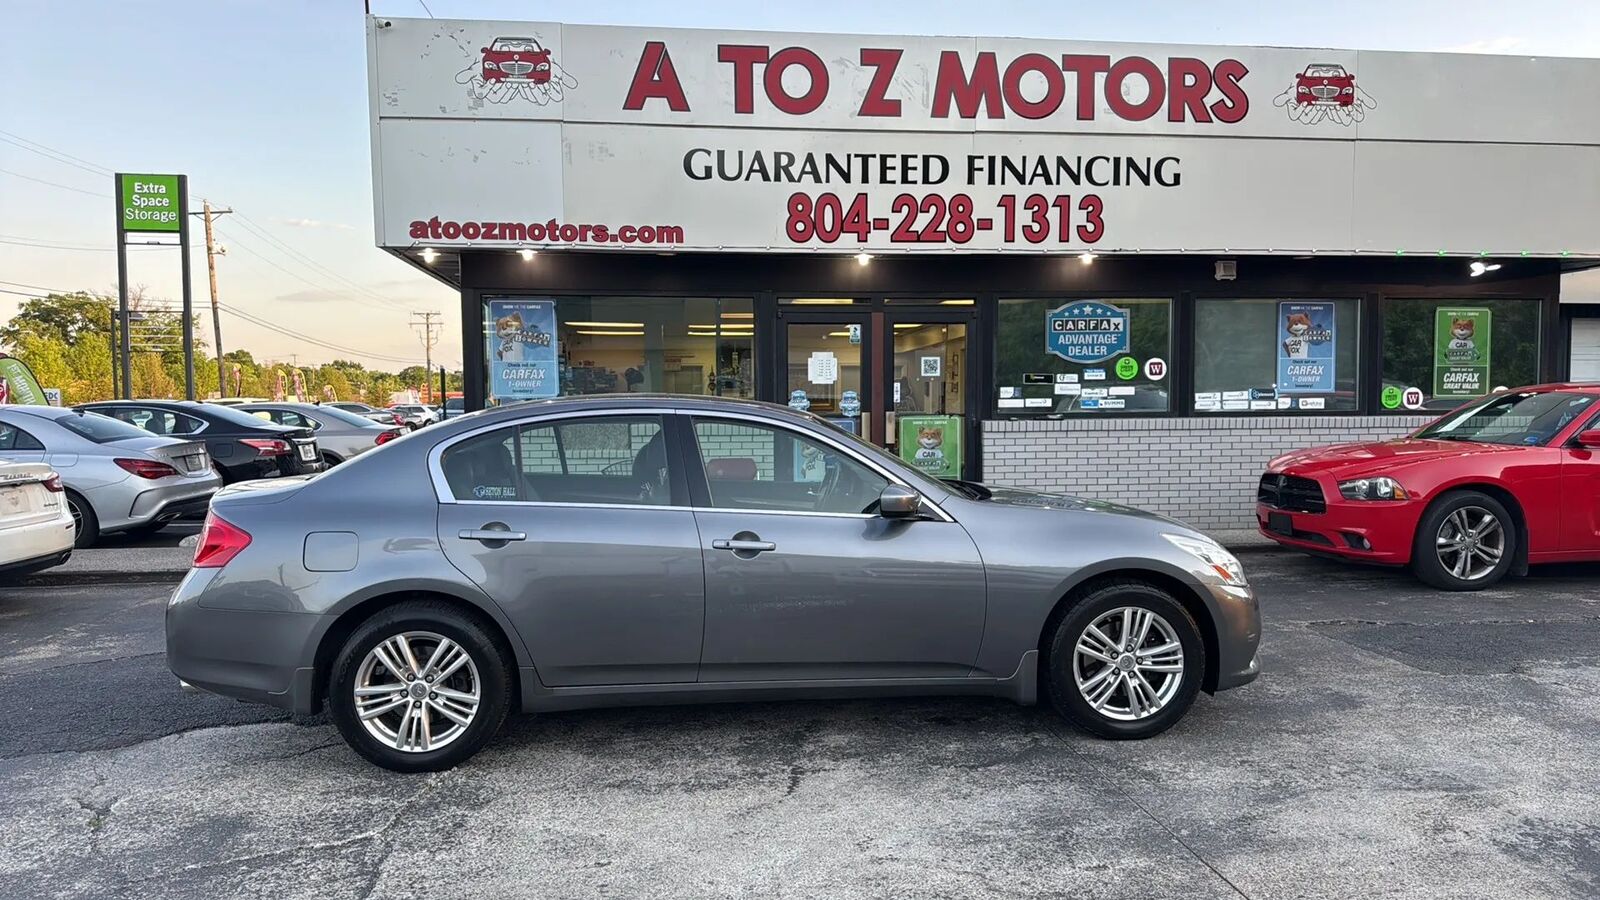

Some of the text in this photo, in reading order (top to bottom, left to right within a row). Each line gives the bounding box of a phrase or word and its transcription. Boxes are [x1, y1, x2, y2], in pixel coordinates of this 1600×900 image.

[622, 40, 1249, 124] A TO Z MOTORS
[683, 148, 1182, 187] GUARANTEED FINANCING
[134, 182, 166, 194] Extra
[132, 194, 170, 208] Space
[125, 207, 177, 223] Storage
[785, 192, 1105, 244] 804-228-1313
[409, 214, 684, 244] atoozmotors.com
[1053, 317, 1123, 332] CARFAX
[1058, 333, 1118, 345] ADVANTAGE
[1068, 345, 1108, 356] DEALER
[502, 368, 546, 379] CARFAX
[1150, 364, 1162, 375] W
[1287, 365, 1324, 375] CARFAX
[1443, 372, 1480, 382] CARFAX
[1408, 394, 1418, 403] W
